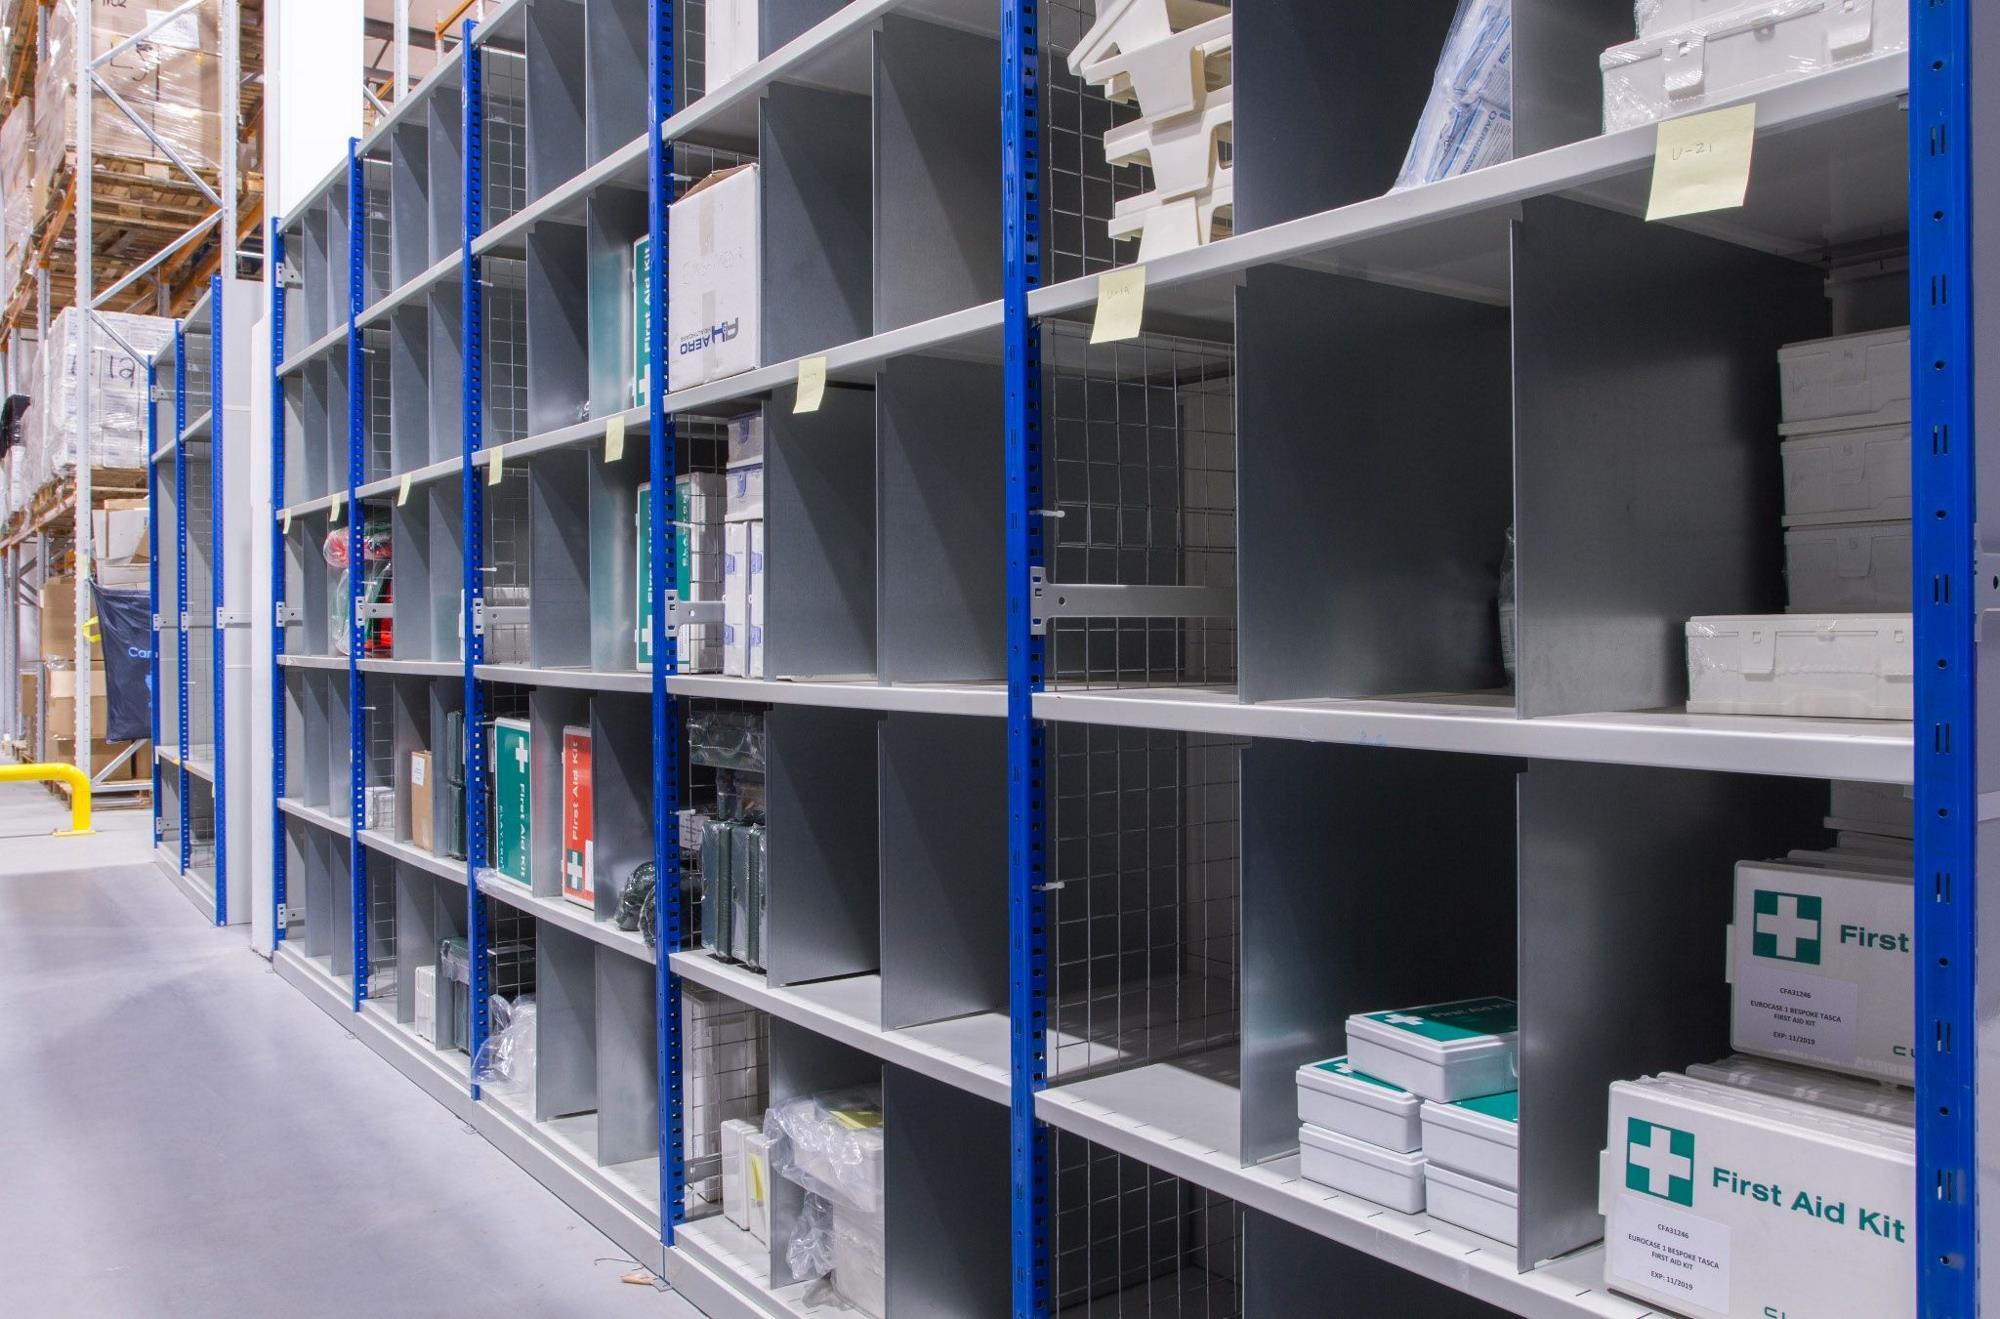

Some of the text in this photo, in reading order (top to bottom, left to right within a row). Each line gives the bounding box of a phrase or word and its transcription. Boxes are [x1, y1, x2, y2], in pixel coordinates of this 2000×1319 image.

[571, 768, 579, 798] Aid
[571, 801, 579, 841] First
[1840, 924, 1910, 954] First
[1750, 1000, 1783, 1012] EUROCASE
[1789, 1007, 1819, 1019] BESPOKE
[1819, 1013, 1842, 1023] TASCA
[1773, 1013, 1791, 1022] FIRST
[1792, 1017, 1805, 1025] AID
[1773, 1031, 1816, 1045] EXP: 11/2019
[1712, 1166, 1906, 1244] First Aid Kit
[1657, 1223, 1690, 1239] CFA31246
[1628, 1233, 1661, 1250] EUROCASE
[1667, 1246, 1697, 1262] BESPOKE
[1698, 1256, 1720, 1270] TASCA
[1651, 1251, 1694, 1271] FIRST AID KIT
[1650, 1270, 1694, 1291] EXP: 11/2019
